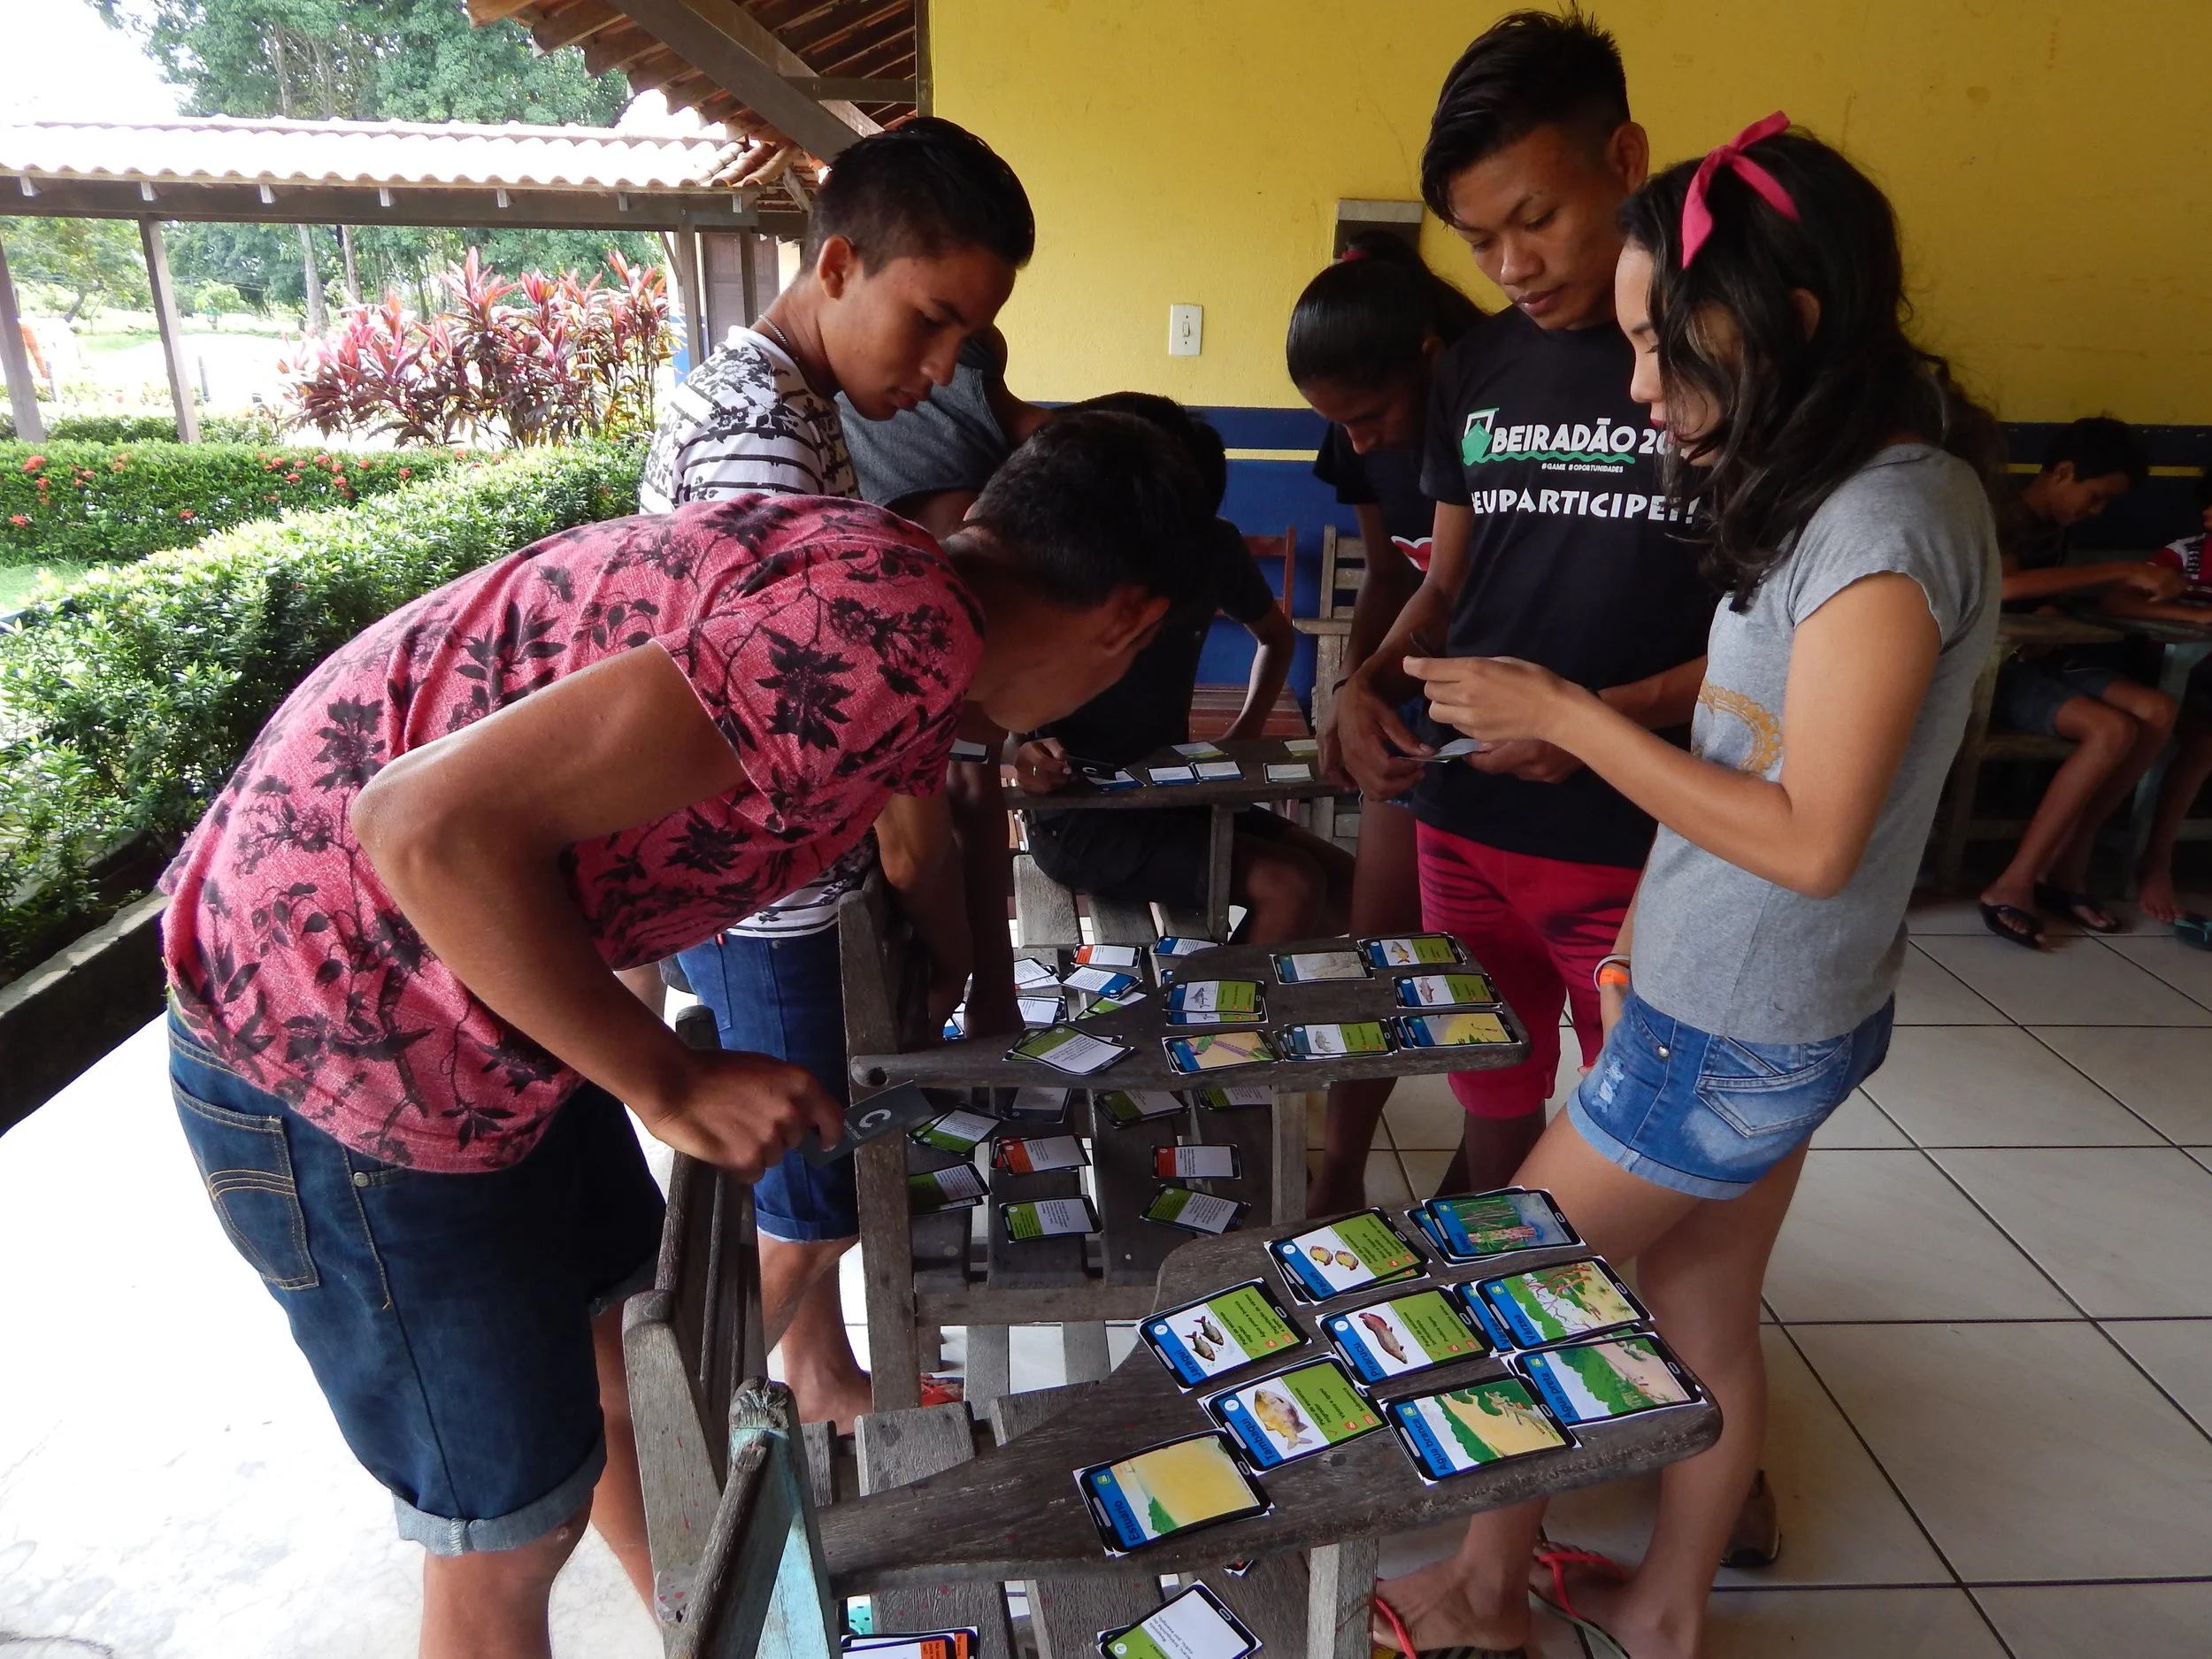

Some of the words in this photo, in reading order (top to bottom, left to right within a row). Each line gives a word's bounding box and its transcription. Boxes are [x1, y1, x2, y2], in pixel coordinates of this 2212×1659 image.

[1491, 418, 1637, 454] BEIRADÃO
[1569, 464, 1624, 472] #OPORTUNIDADES
[1309, 1271, 1330, 1294] Pacus
[1514, 1314, 1535, 1341] Várzea
[1174, 1349, 1201, 1377] Jaraqui
[1354, 1342, 1380, 1377] Pirarucu
[1541, 1372, 1562, 1394] preta
[1555, 1395, 1574, 1418] Água
[1240, 1418, 1274, 1461] Tambaqui
[1412, 1418, 1433, 1448] branca
[1430, 1448, 1448, 1470] Água
[1114, 1501, 1140, 1541] Estuário
